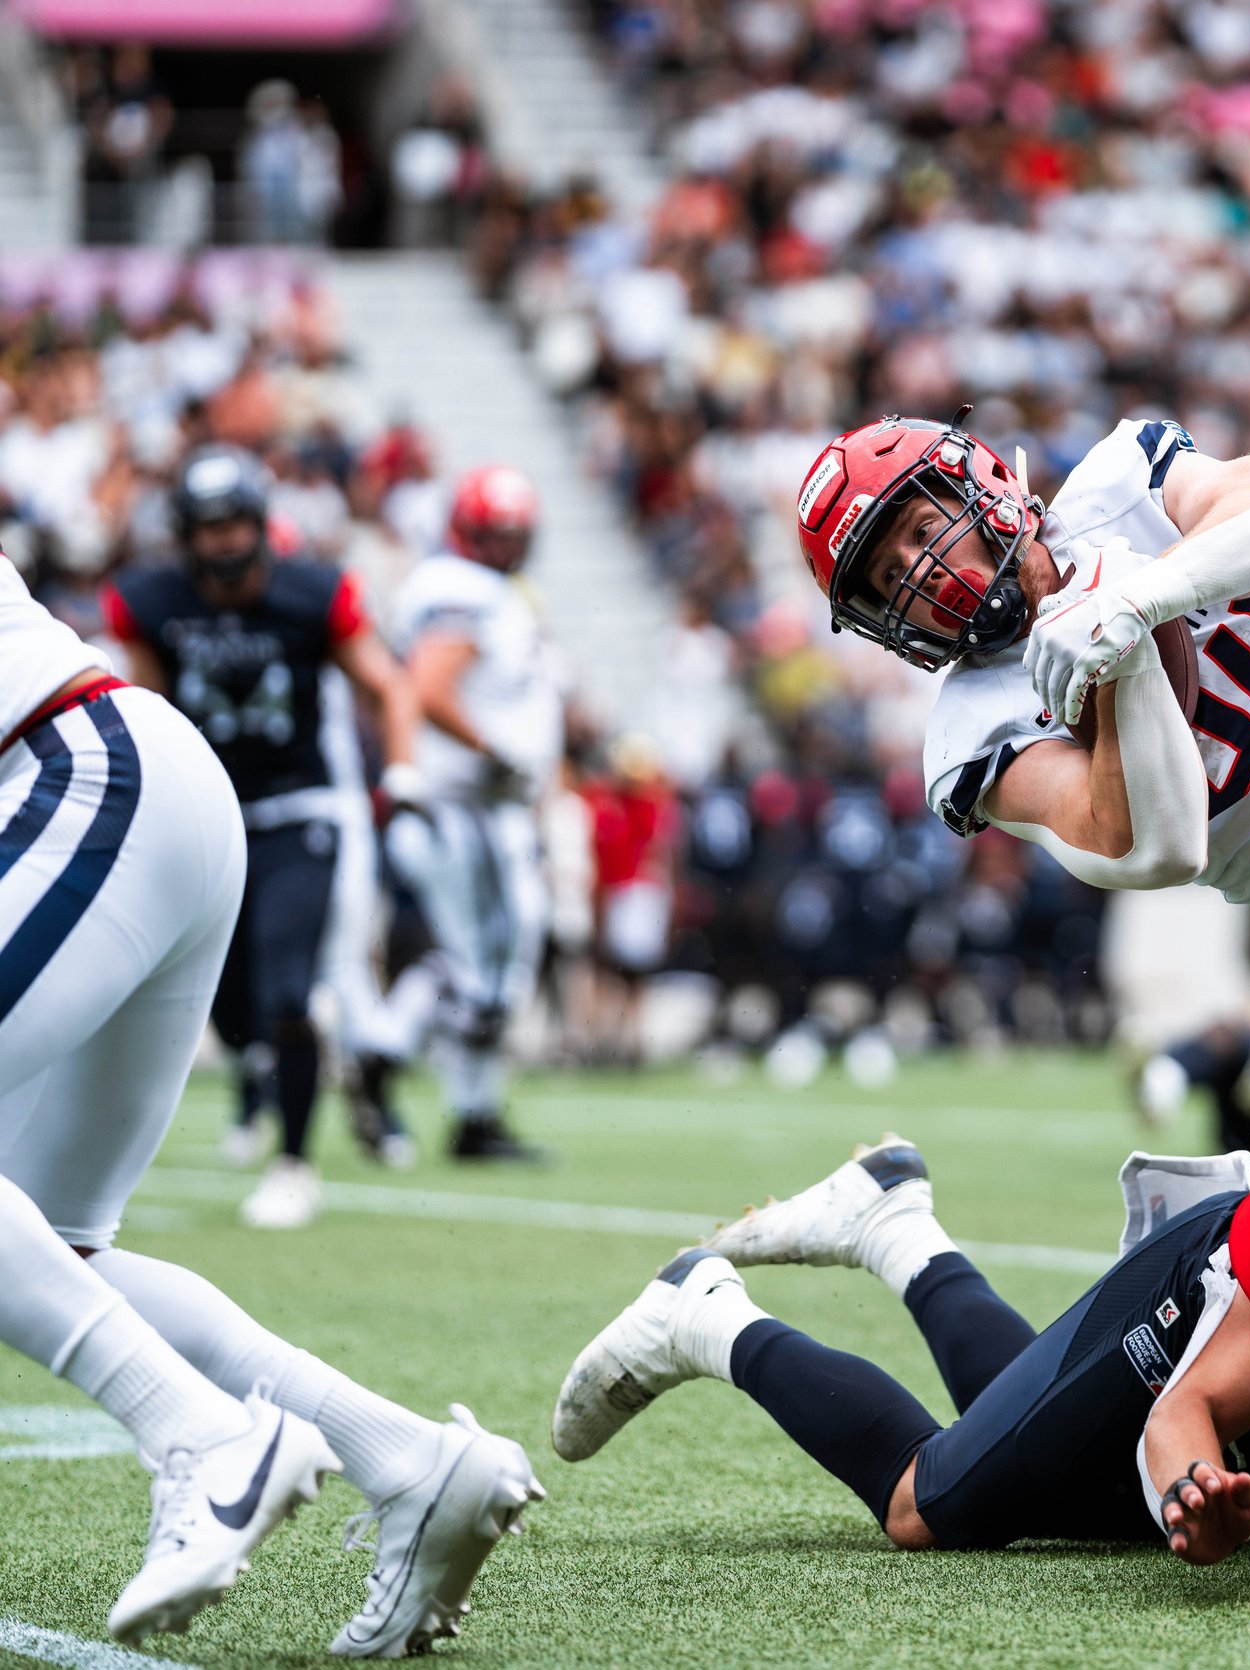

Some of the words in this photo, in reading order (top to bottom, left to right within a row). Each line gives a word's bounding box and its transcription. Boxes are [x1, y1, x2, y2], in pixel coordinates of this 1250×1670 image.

[801, 464, 831, 513] DEFSHOP
[830, 503, 862, 551] FORELLE
[1127, 1336, 1149, 1370] FOOTBALL
[1133, 1332, 1151, 1357] LEAGUE
[1139, 1328, 1163, 1364] EUROPEAN
